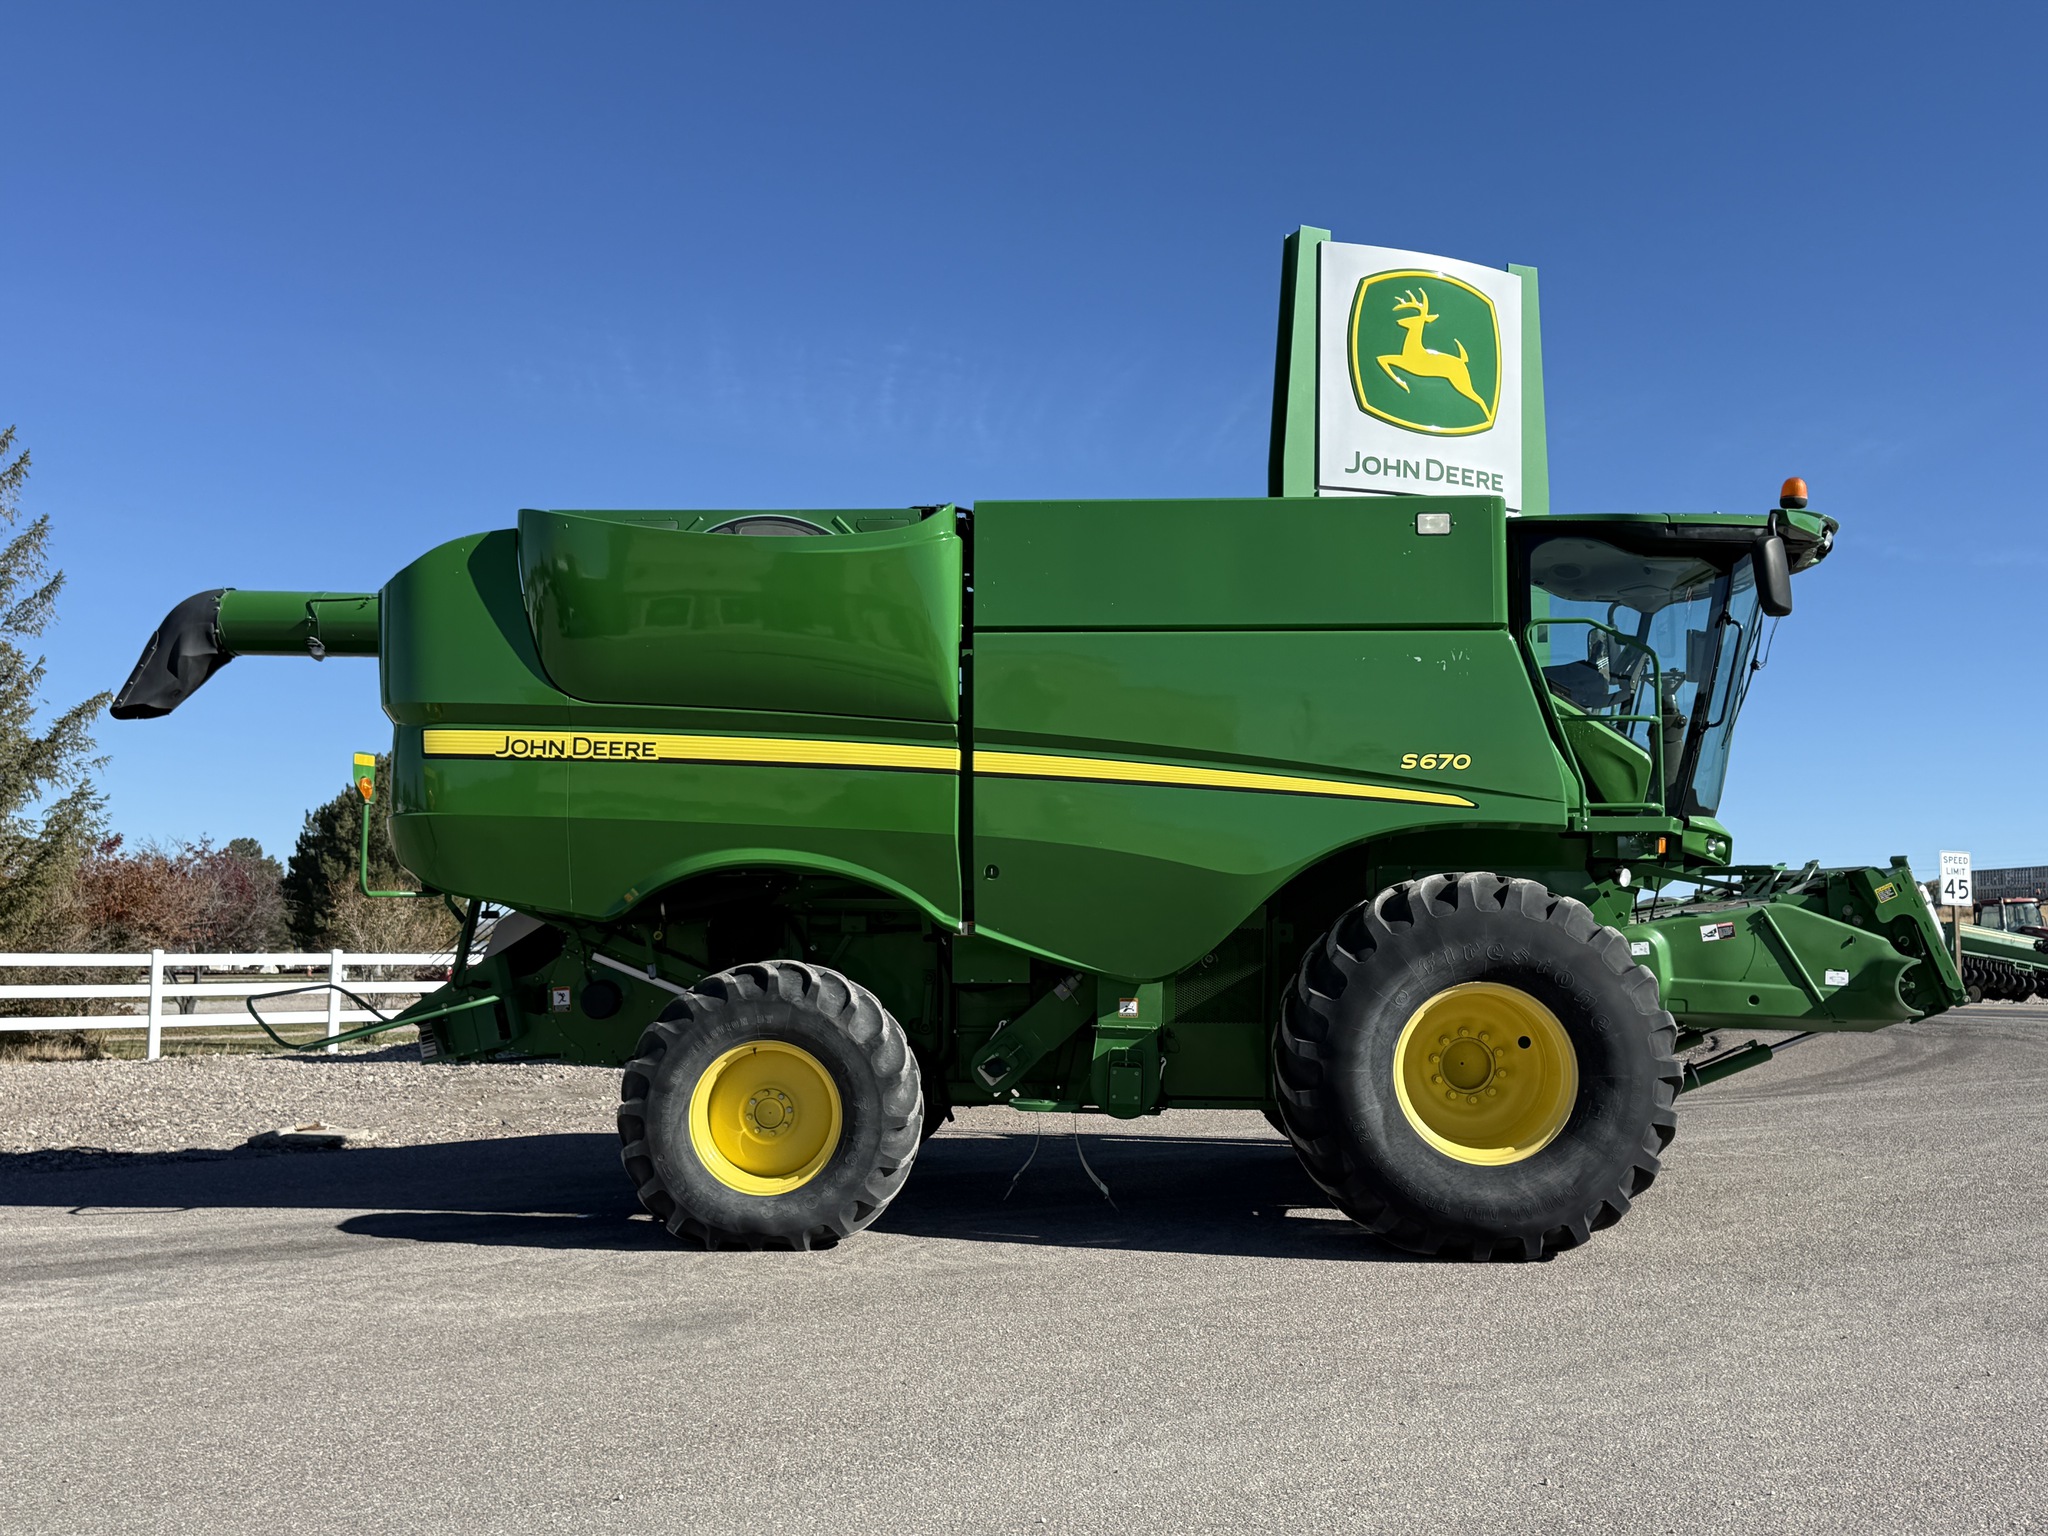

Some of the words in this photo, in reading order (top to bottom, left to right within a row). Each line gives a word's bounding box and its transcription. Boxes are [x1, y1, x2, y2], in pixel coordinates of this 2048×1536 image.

[1345, 451, 1420, 480] JOHN
[1425, 458, 1504, 492] DEERE
[495, 735, 566, 756] JOHN
[572, 737, 657, 758] DEERE
[1400, 752, 1472, 770] S670
[1942, 855, 1969, 865] SPEED
[1945, 867, 1966, 875] LIMIT
[1944, 879, 1969, 900] 45
[1417, 941, 1612, 1033] Firestone
